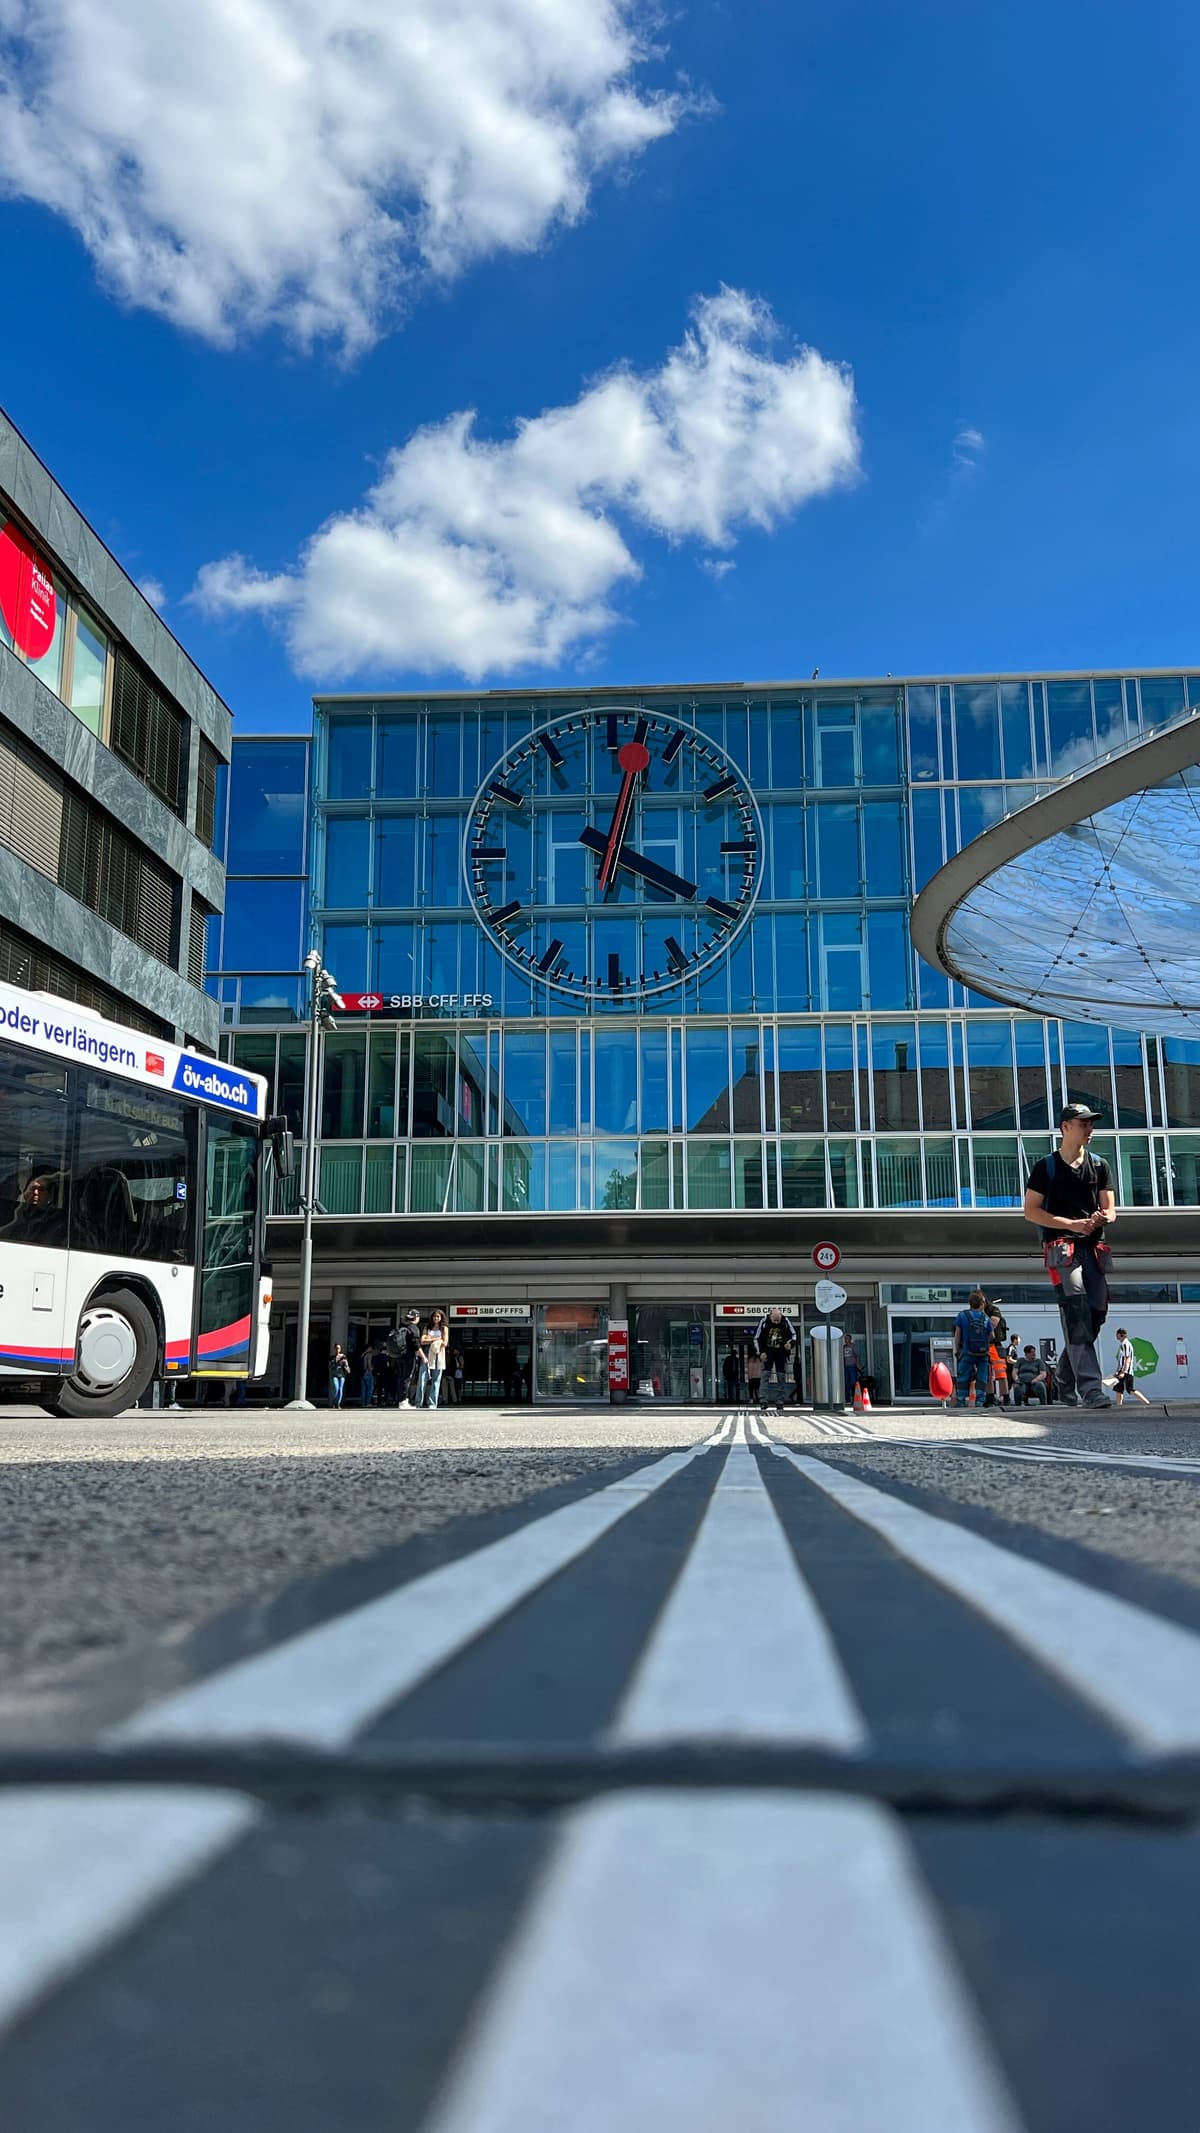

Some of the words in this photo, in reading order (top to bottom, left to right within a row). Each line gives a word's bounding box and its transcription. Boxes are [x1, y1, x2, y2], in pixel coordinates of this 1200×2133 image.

[390, 995, 423, 1008] SBB
[429, 994, 458, 1007] CFF
[463, 994, 493, 1007] FFS
[44, 1022, 138, 1069] verlängern.
[183, 1064, 248, 1105] öv-abo.ch
